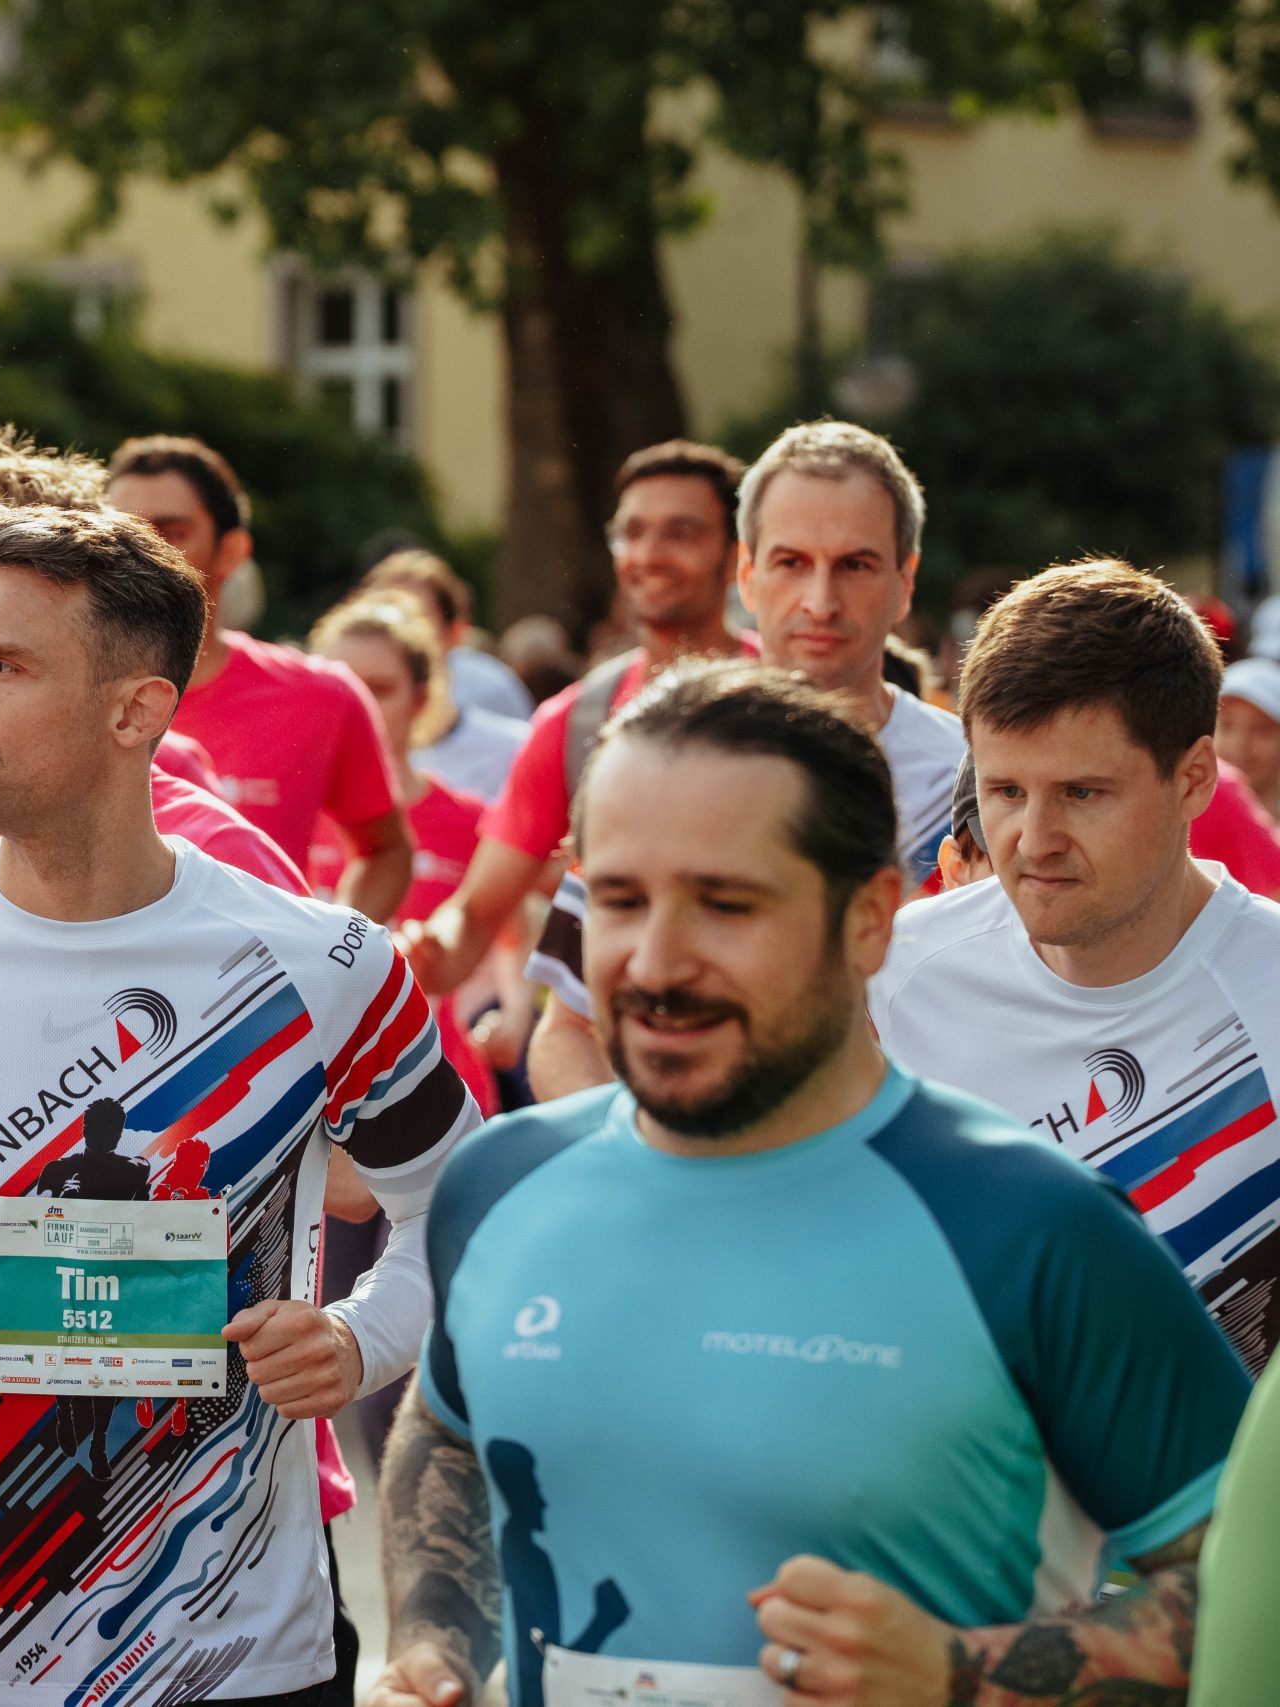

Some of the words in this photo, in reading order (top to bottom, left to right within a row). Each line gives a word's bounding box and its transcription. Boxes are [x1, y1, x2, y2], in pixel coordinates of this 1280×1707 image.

[47, 1206, 62, 1214] dm
[47, 1223, 75, 1232] FIRMEN
[47, 1232, 74, 1244] LAUF
[56, 1266, 119, 1301] Tim
[62, 1310, 112, 1330] 5512
[57, 1335, 87, 1344] STARTZEIT
[15, 1642, 48, 1675] 1954
